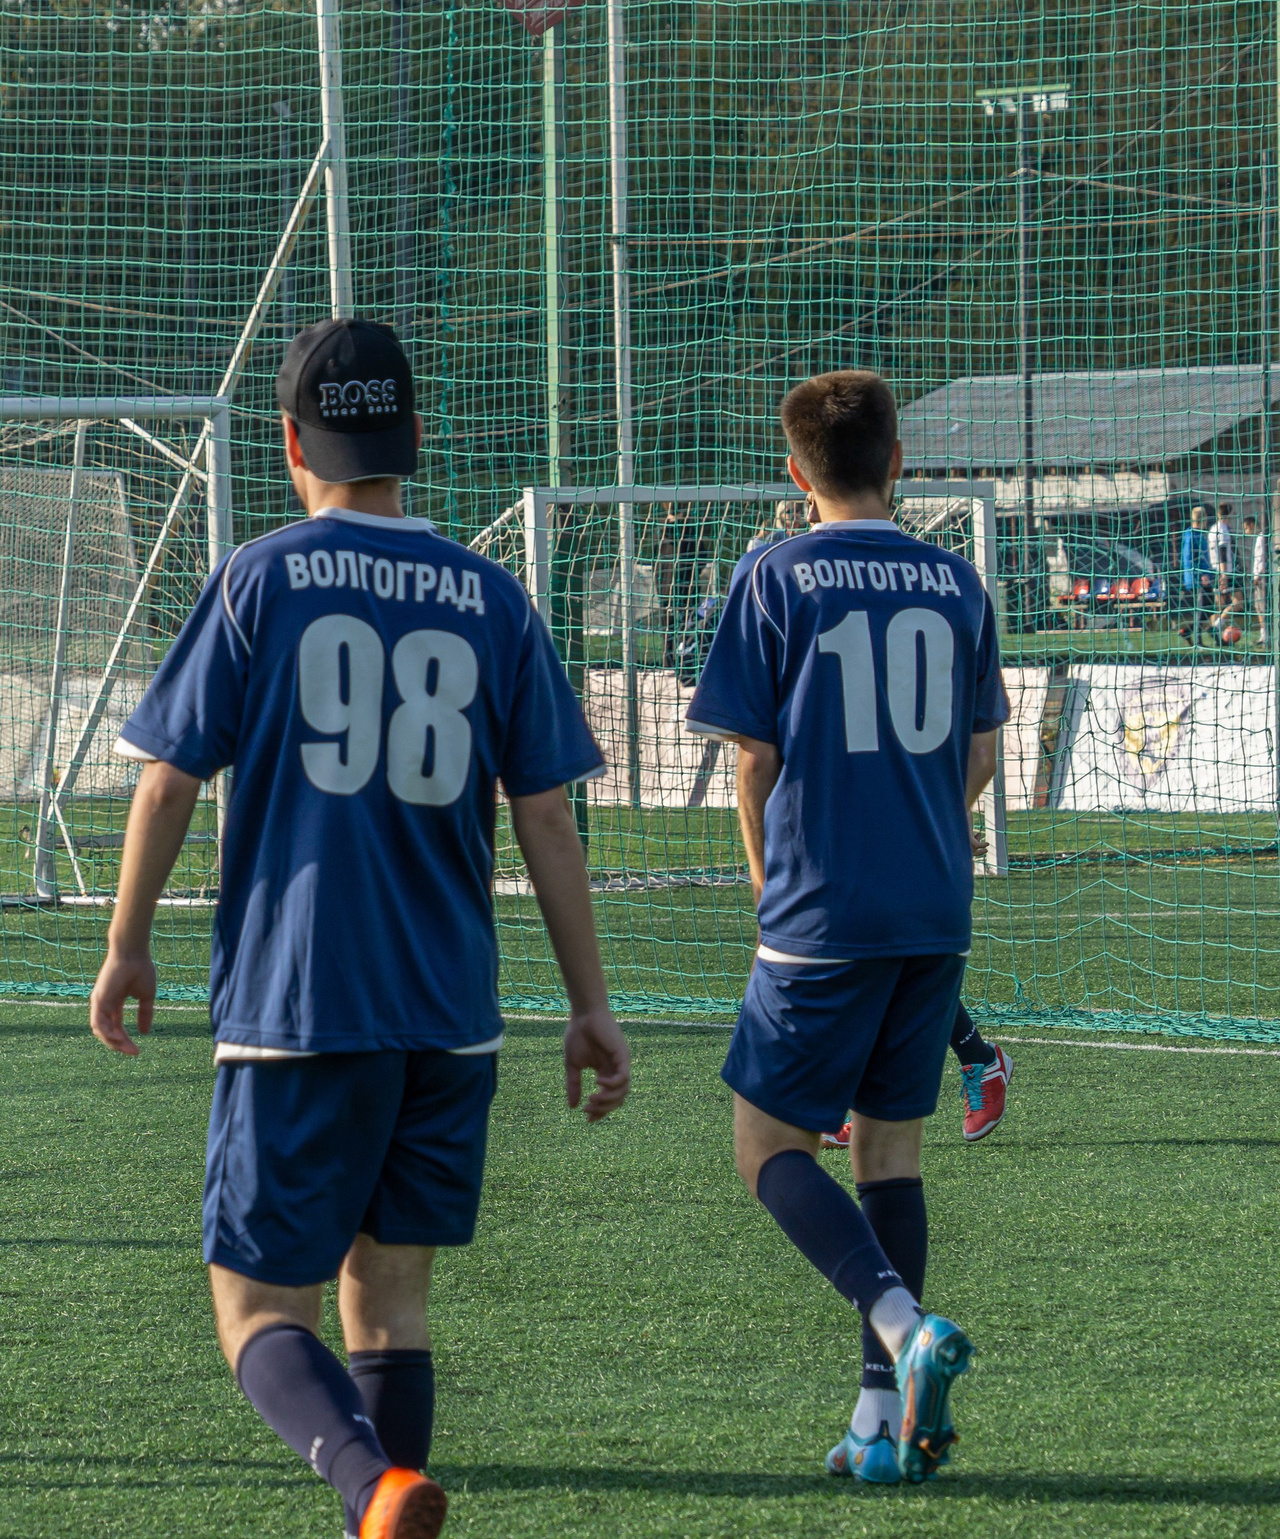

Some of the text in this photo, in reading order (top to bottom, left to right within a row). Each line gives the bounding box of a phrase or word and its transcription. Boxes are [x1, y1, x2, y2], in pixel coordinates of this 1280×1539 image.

[319, 379, 397, 409] BOSS
[323, 404, 398, 417] HUGO BOSS
[285, 550, 485, 616] ВОЛГОГРАД
[793, 559, 961, 597] ВОЛГОГРАД
[818, 607, 954, 754] 10
[299, 614, 478, 807] 98
